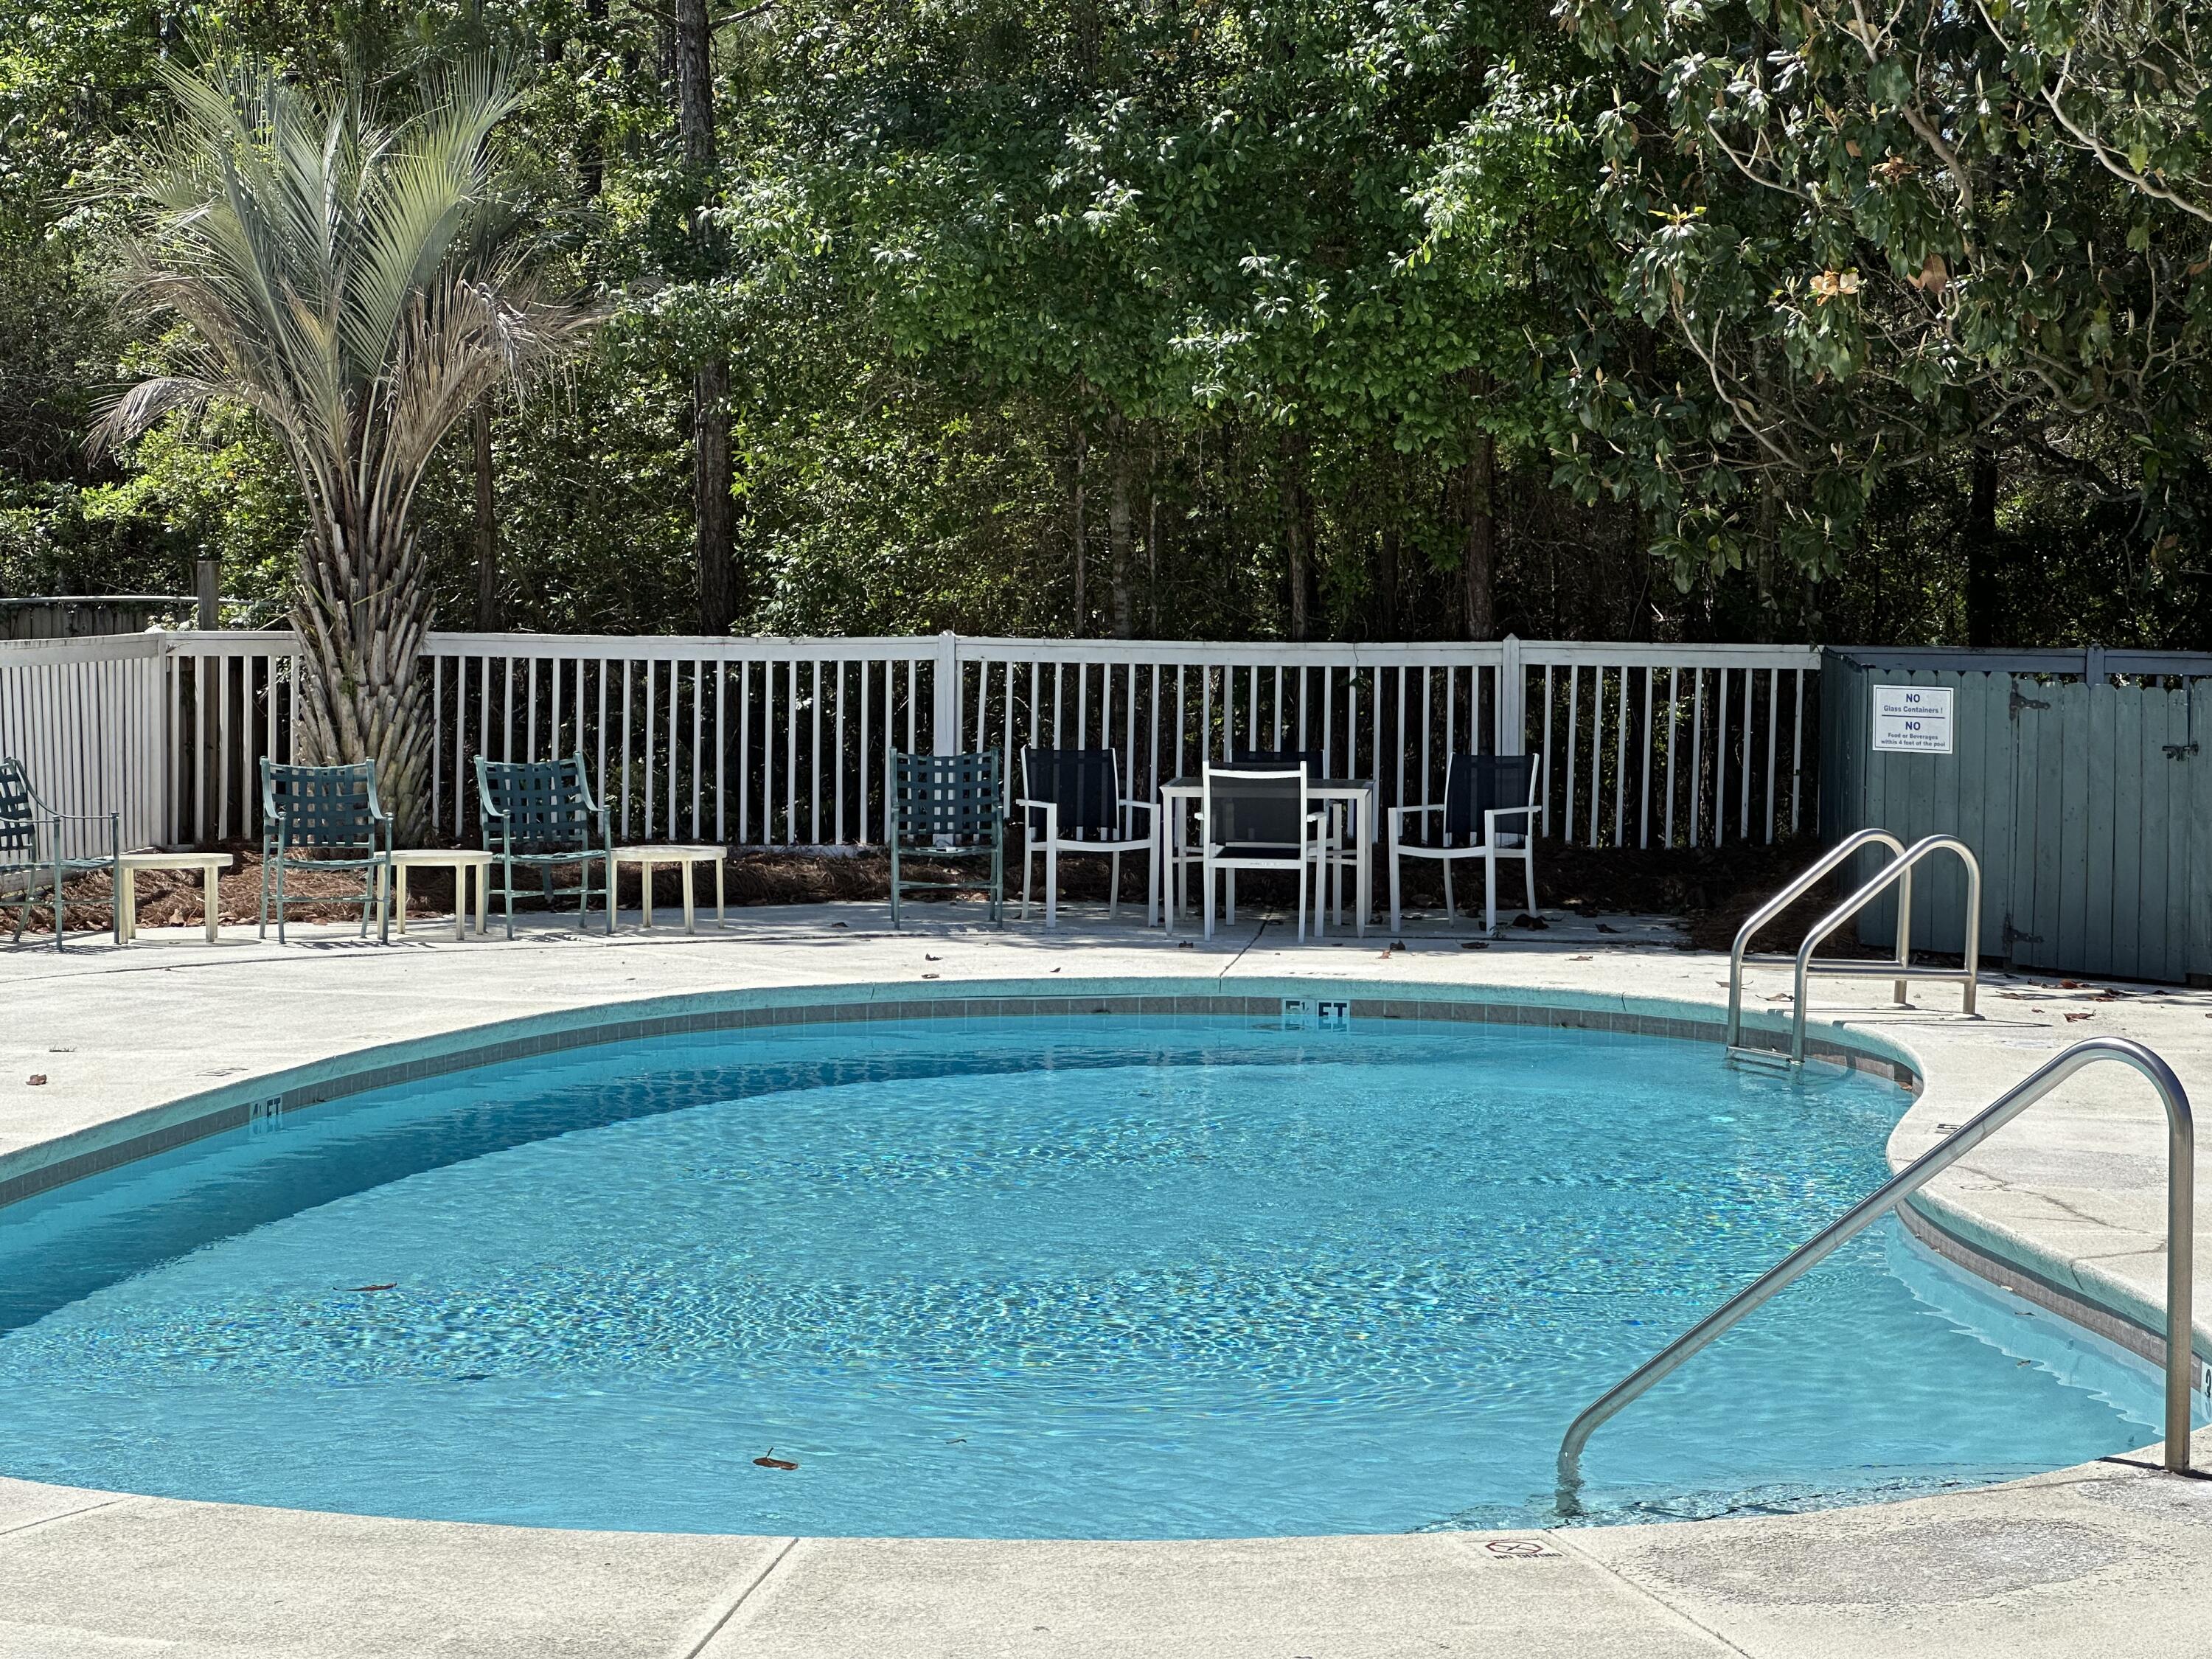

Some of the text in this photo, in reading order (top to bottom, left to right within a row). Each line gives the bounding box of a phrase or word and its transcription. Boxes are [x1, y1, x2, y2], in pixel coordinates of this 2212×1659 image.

[1905, 693, 1921, 703] NO
[1903, 706, 1939, 714] Containers
[1905, 721, 1921, 731] NO
[1909, 733, 1938, 741] Beverages
[1318, 1002, 1348, 1018] FT
[266, 1096, 281, 1117] FT
